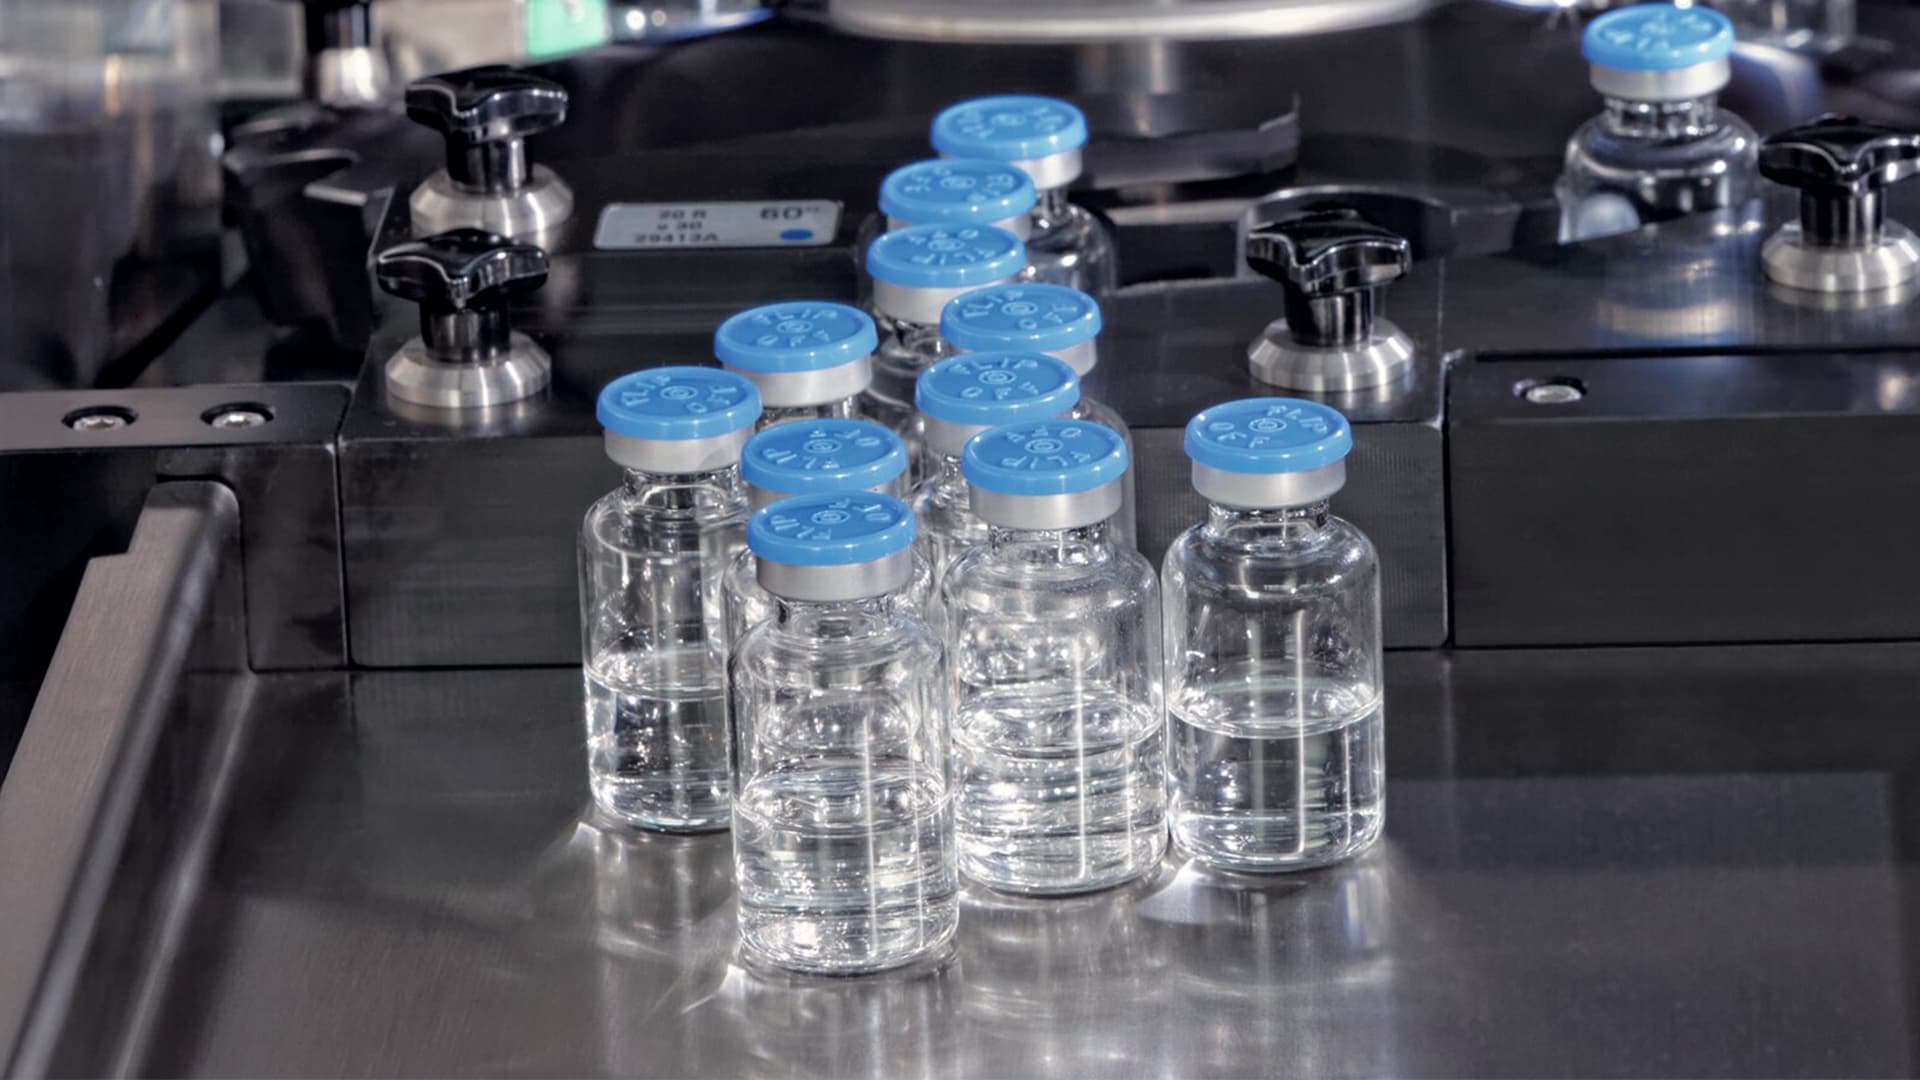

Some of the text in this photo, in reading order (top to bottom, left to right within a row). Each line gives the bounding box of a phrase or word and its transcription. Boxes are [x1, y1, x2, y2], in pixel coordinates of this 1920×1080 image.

[760, 206, 803, 220] 60
[1267, 405, 1328, 433] FLIP
[1209, 422, 1270, 448] OFF
